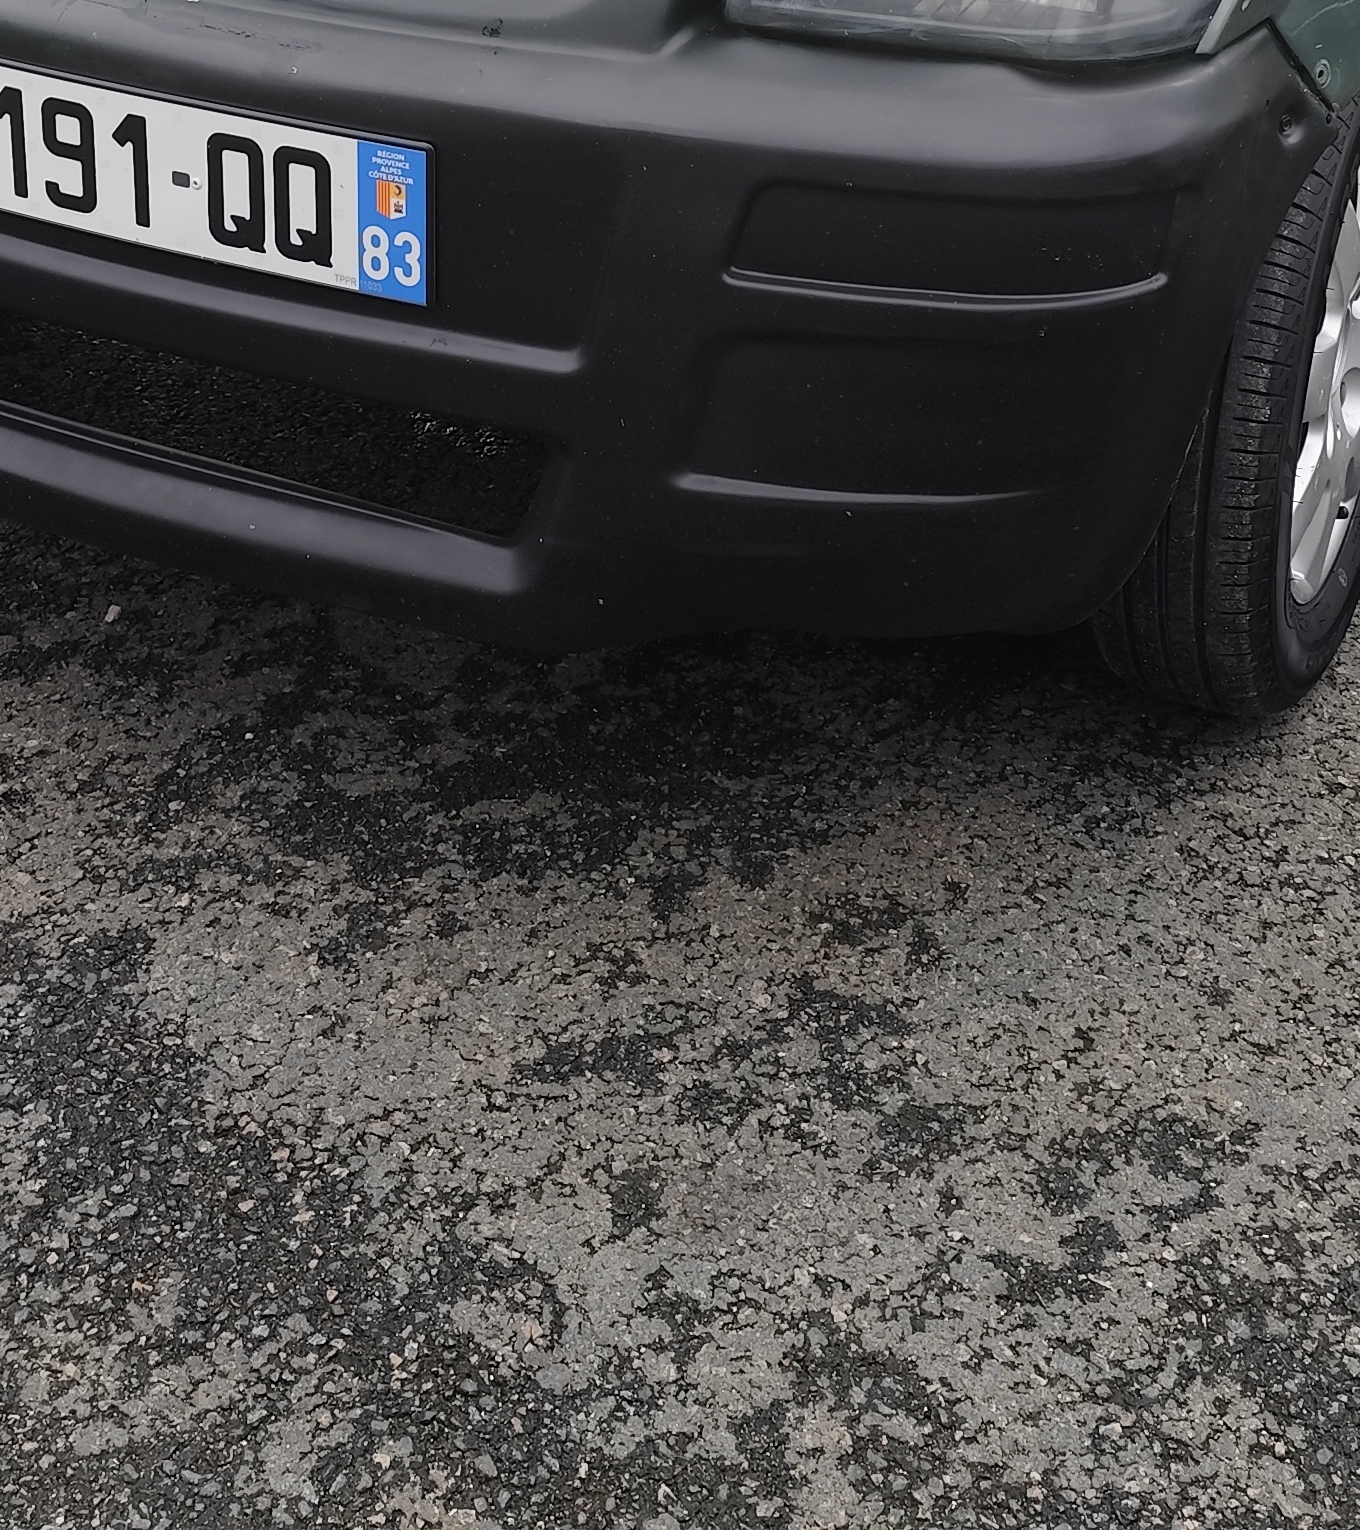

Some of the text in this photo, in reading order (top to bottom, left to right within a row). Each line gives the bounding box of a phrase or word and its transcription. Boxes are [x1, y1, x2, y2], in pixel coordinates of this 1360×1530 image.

[377, 149, 405, 162] RÉGION
[371, 157, 410, 170] PROVENCE
[380, 165, 403, 176] ALPES
[368, 169, 414, 186] CÔTE D'AZUR
[362, 225, 421, 287] 83
[334, 273, 357, 286] TPPR
